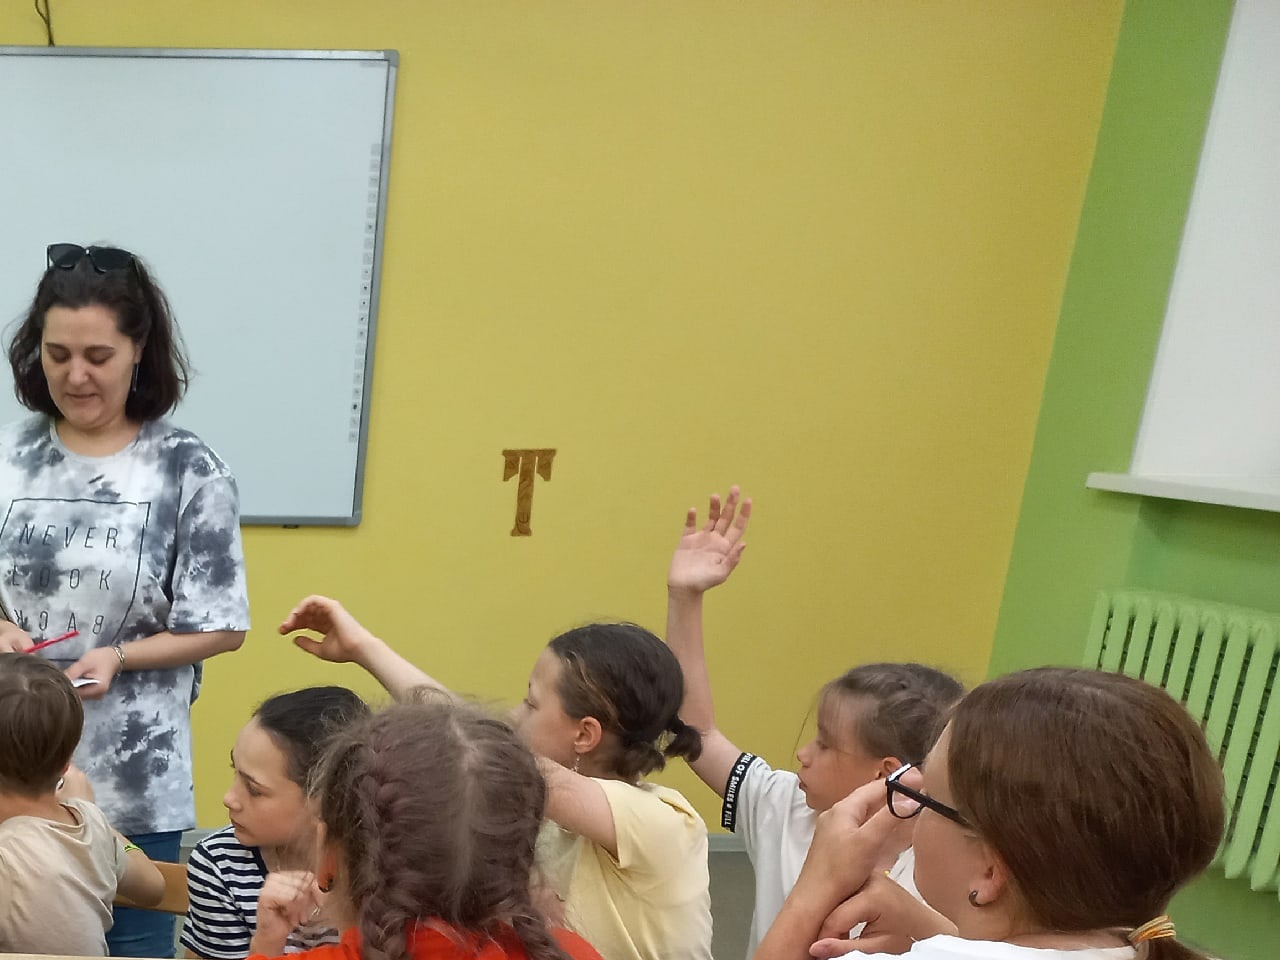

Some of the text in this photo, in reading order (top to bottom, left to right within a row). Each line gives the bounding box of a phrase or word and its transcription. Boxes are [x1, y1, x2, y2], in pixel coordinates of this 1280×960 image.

[19, 523, 118, 548] NEVER
[12, 565, 112, 589] LOOK
[726, 776, 740, 802] SMILES
